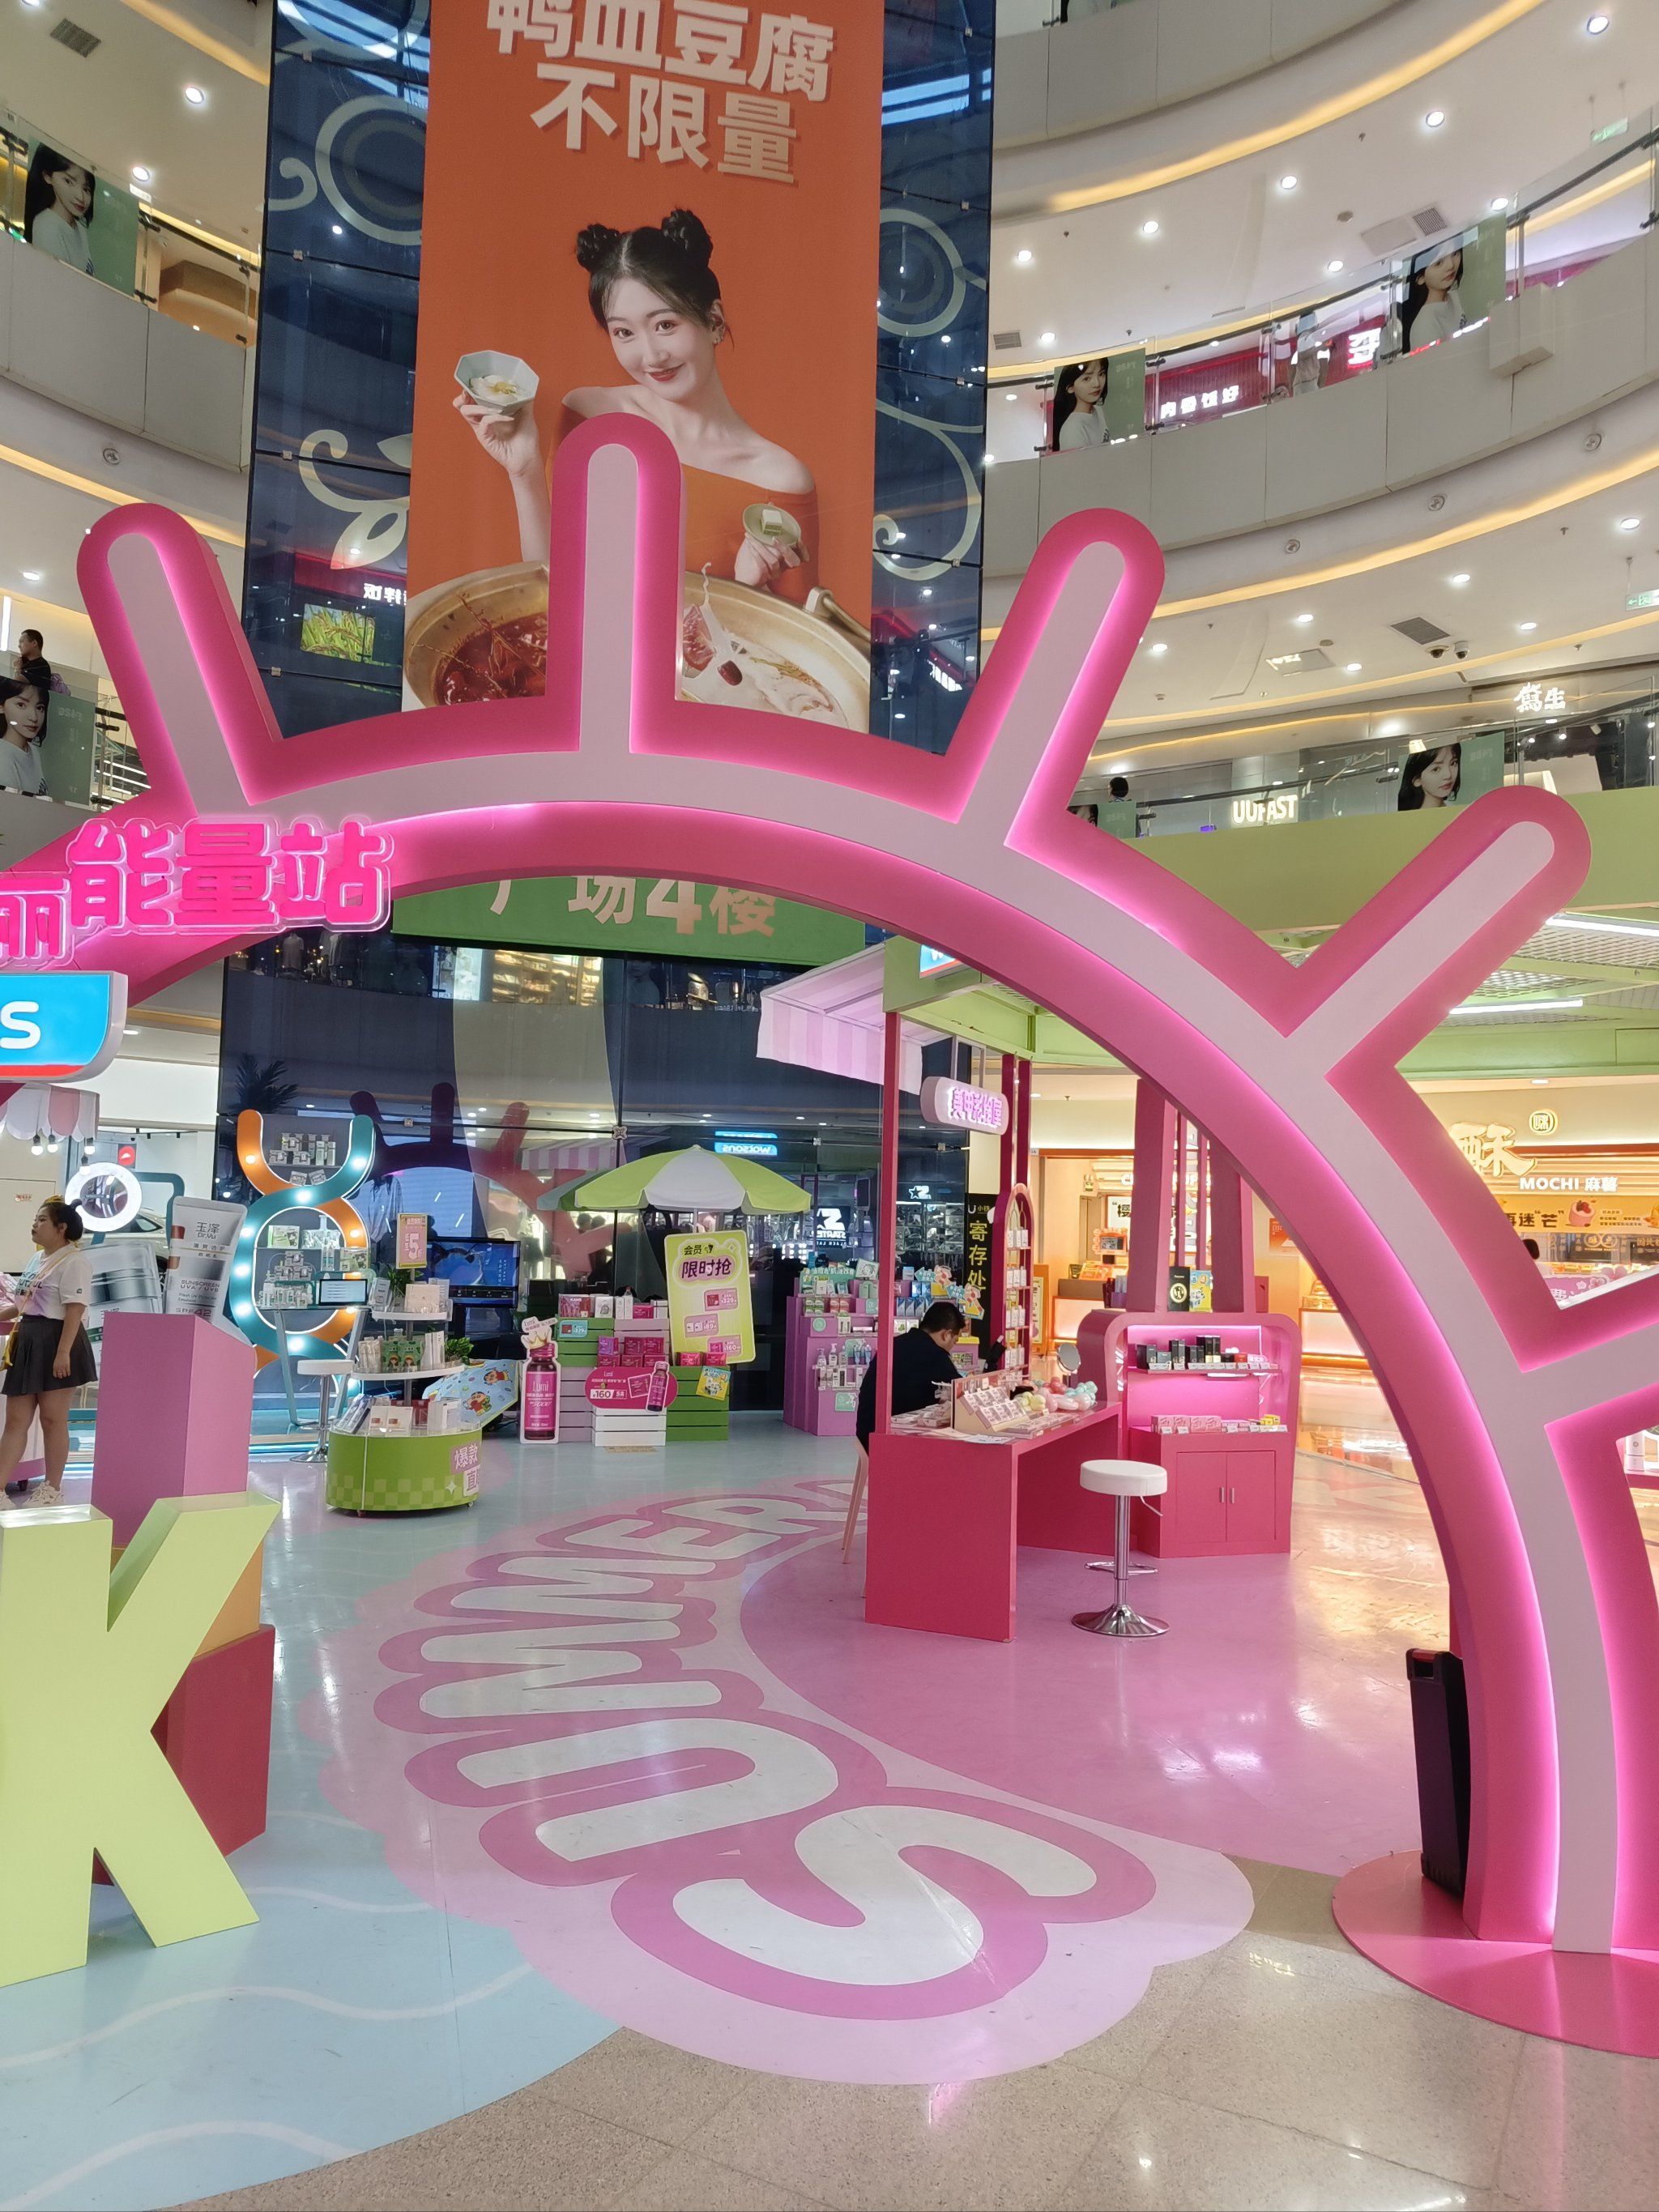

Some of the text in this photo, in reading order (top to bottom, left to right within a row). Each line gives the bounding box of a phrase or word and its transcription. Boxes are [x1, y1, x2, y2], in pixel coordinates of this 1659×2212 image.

[486, 0, 834, 102] 鸭血豆腐
[530, 62, 798, 184] 不限量
[1519, 1177, 1618, 1191] MOCHI 麻薯
[195, 1221, 220, 1234] 玉泽
[684, 1244, 702, 1255] 会员
[967, 1220, 988, 1291] 寄存处
[682, 1257, 732, 1279] 限时抢
[181, 1280, 220, 1289] SUNSCREEN
[532, 1380, 549, 1392] Lumi
[454, 1443, 478, 1470] 爆款
